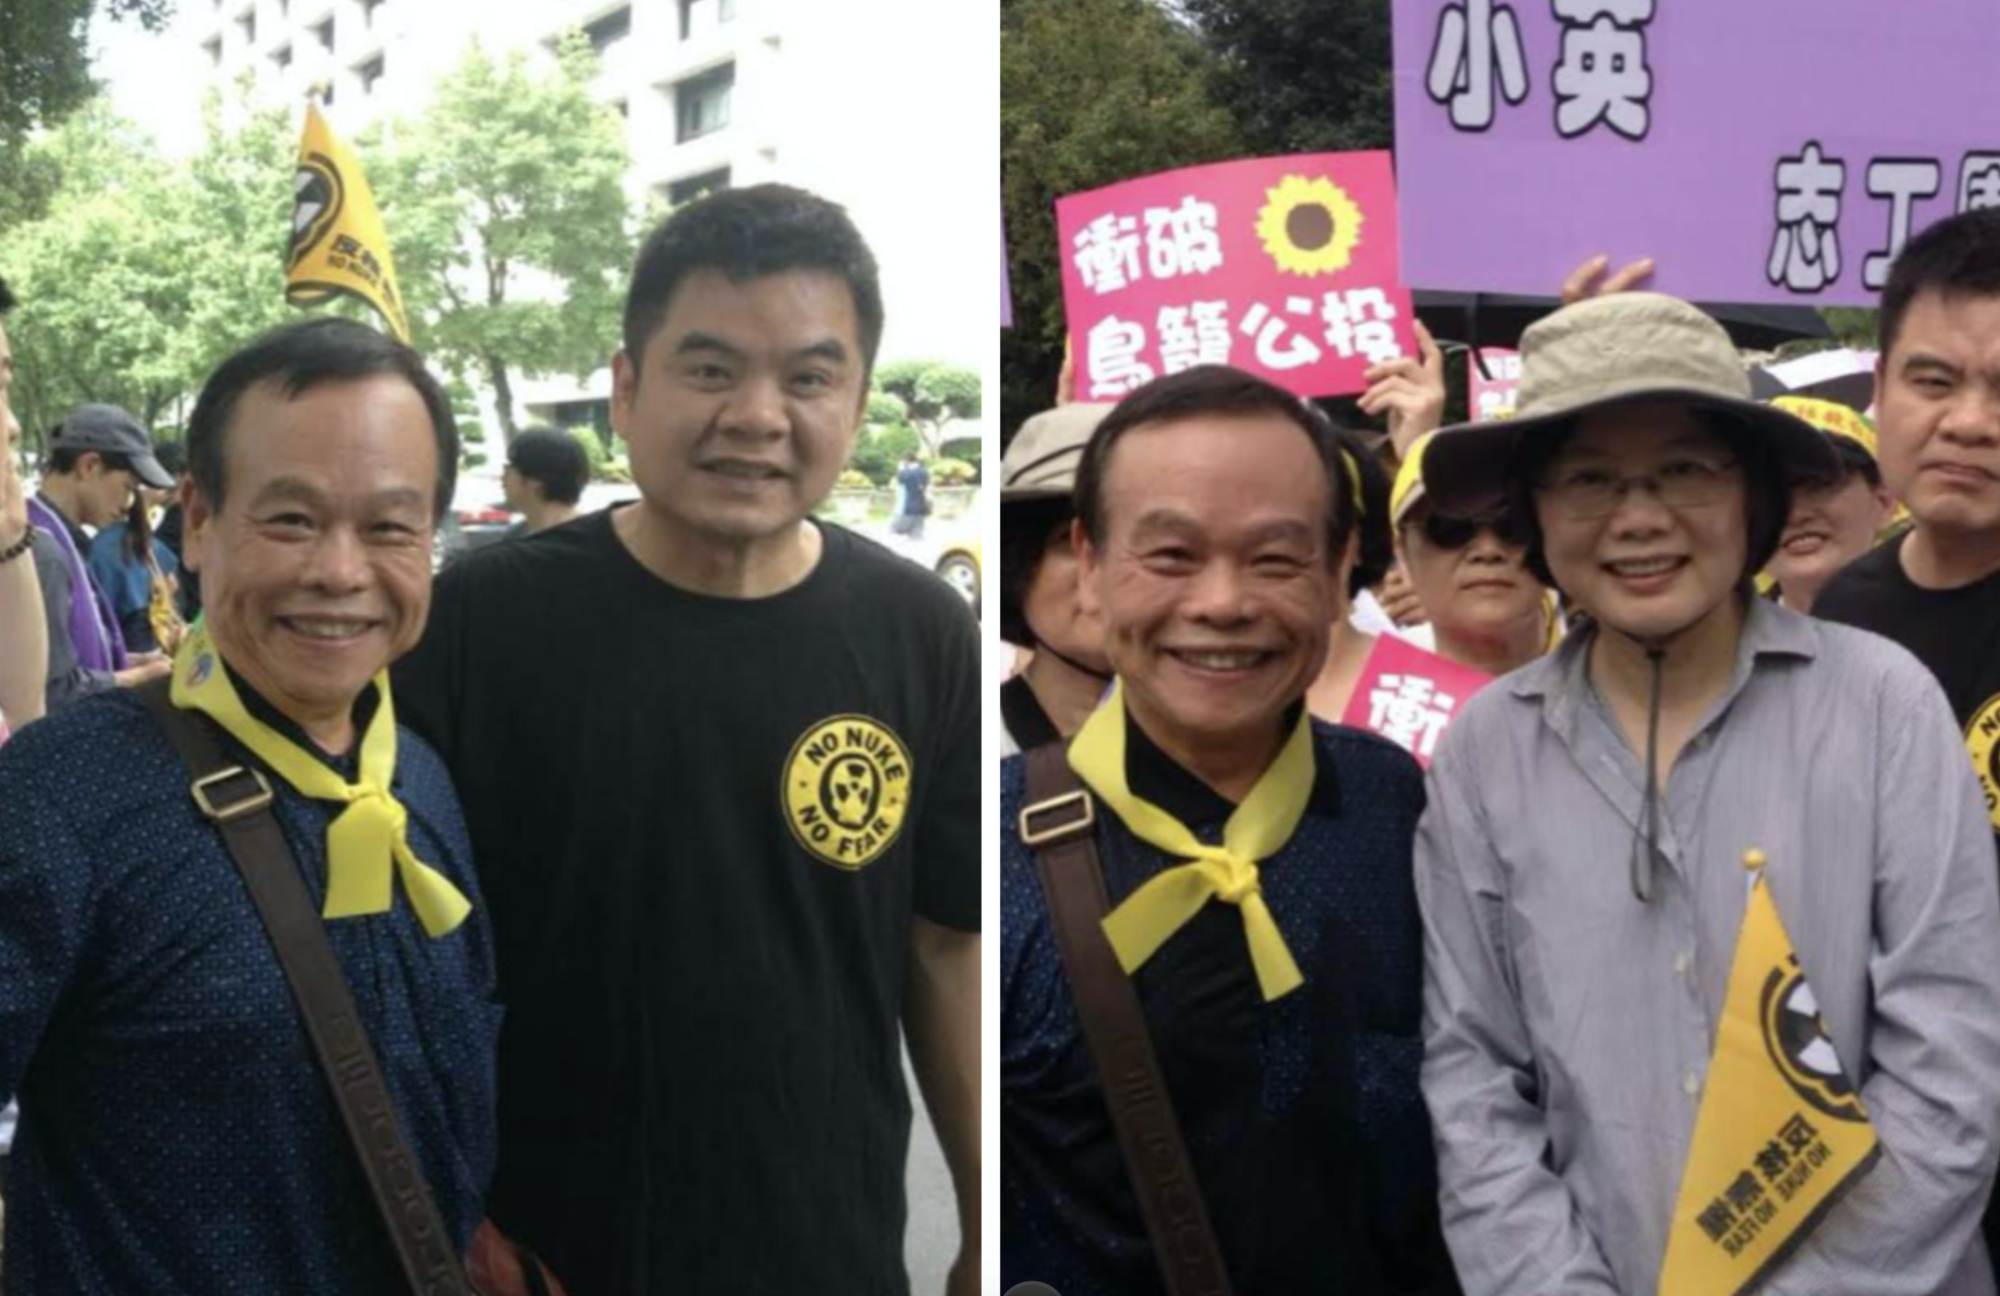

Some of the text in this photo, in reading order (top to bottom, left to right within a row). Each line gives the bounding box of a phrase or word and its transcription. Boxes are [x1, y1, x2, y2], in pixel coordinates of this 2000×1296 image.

[1425, 0, 1653, 141] 小英
[1073, 196, 1224, 294] 衝破
[1767, 139, 2000, 293] 志工
[1087, 287, 1402, 398] 鳥籠公投
[804, 727, 905, 782] NO NUKE
[1369, 672, 1455, 757] 衝
[798, 804, 890, 857] NO FEAR
